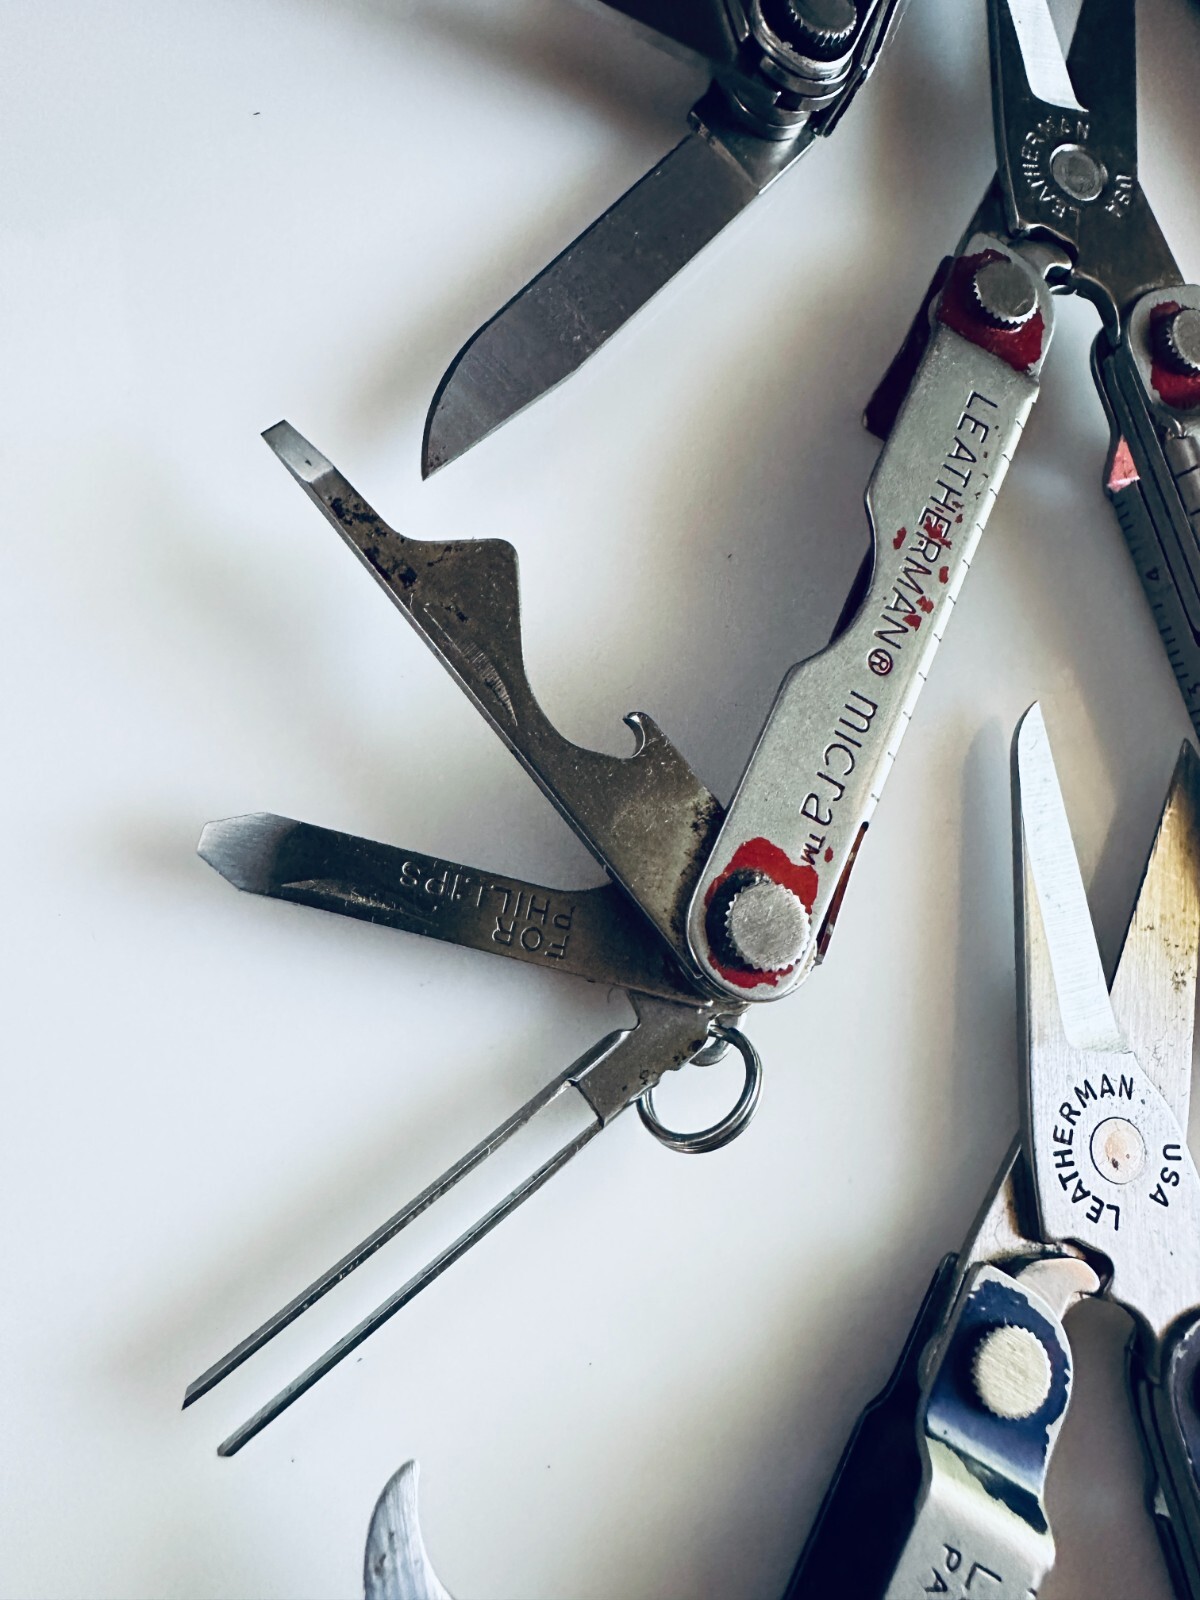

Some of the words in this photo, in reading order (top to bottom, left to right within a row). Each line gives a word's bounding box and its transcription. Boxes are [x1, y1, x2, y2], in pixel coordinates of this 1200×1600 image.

[1021, 115, 1090, 220] LEATHERMAN
[1104, 174, 1132, 219] USA
[491, 916, 570, 960] FOR
[1052, 1073, 1135, 1232] LEATHERMAN
[1149, 1143, 1183, 1208] USA
